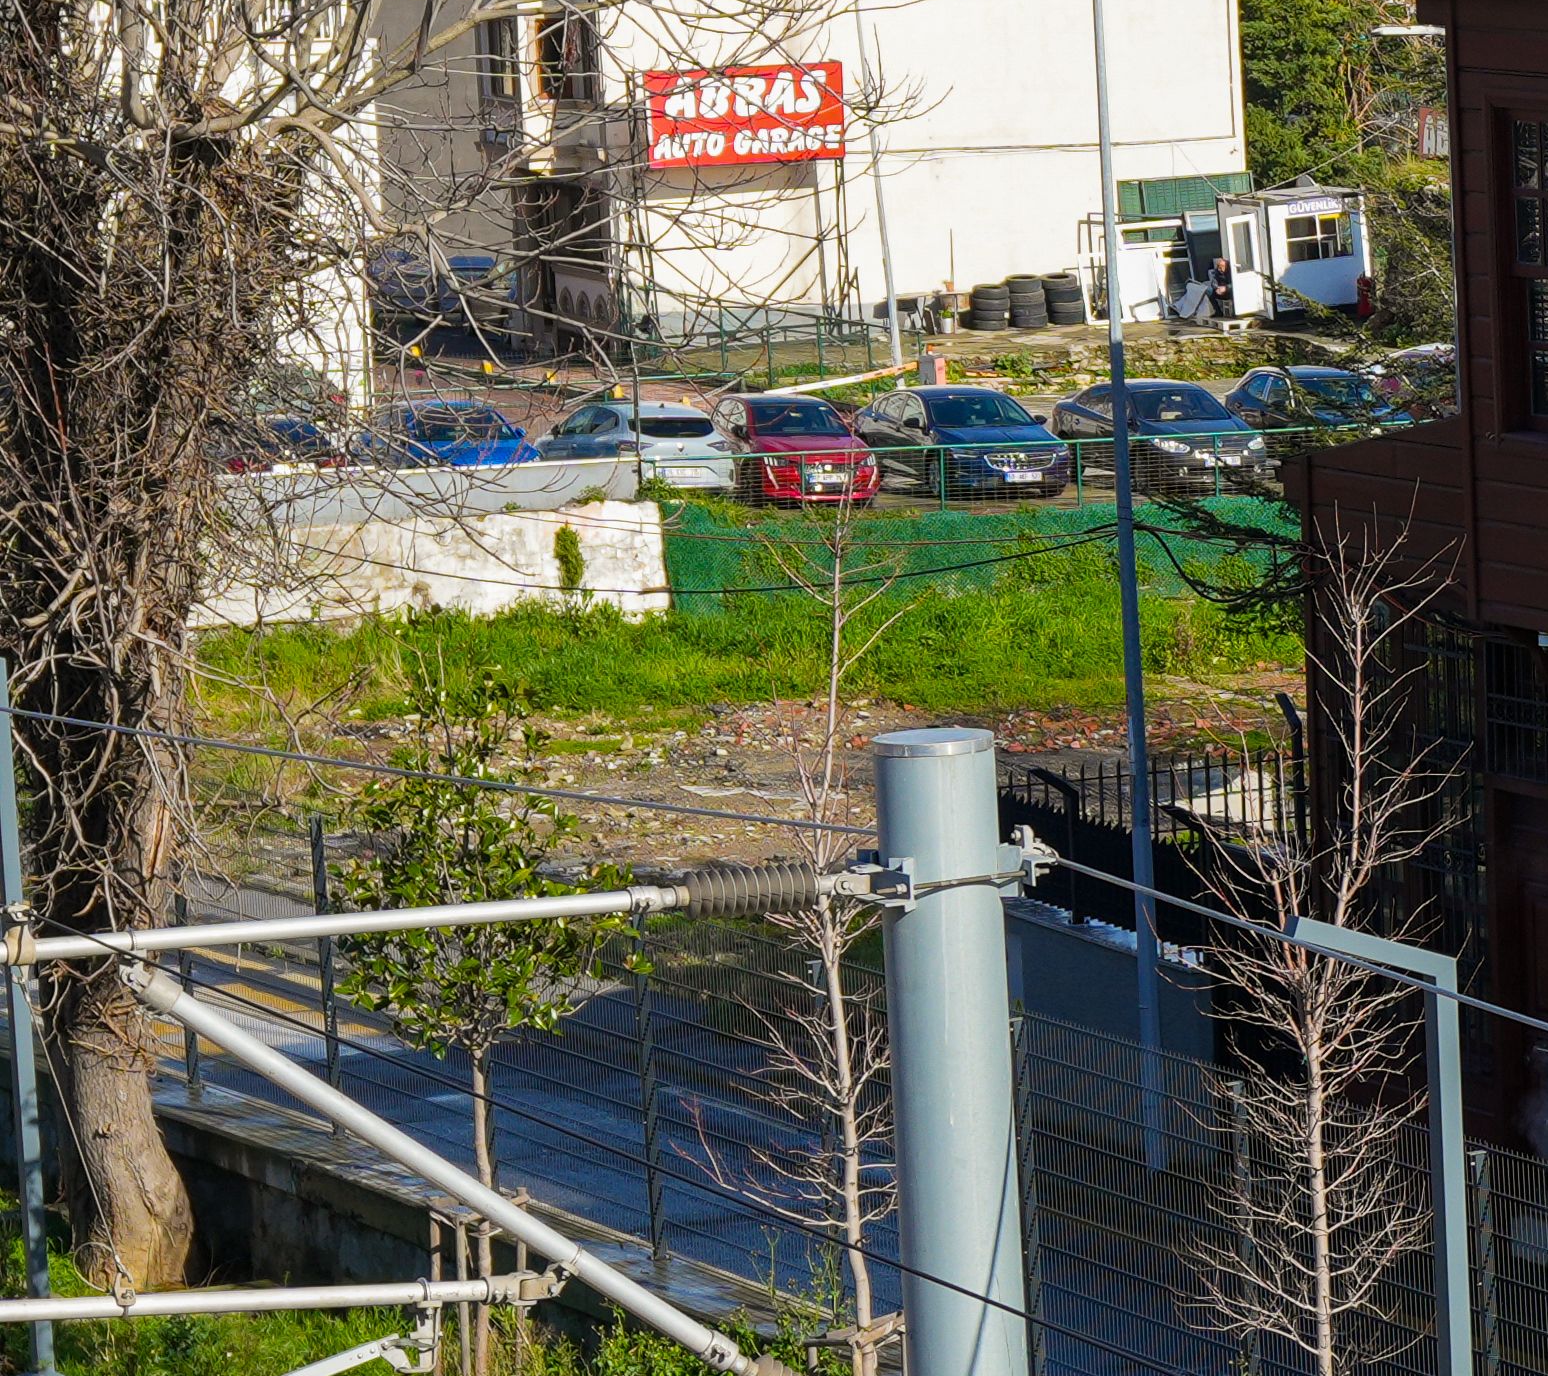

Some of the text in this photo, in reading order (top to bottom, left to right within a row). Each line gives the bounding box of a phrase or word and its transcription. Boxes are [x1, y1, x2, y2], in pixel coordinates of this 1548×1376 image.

[664, 70, 827, 121] ABBAS
[653, 124, 842, 160] AUTO GARAGE
